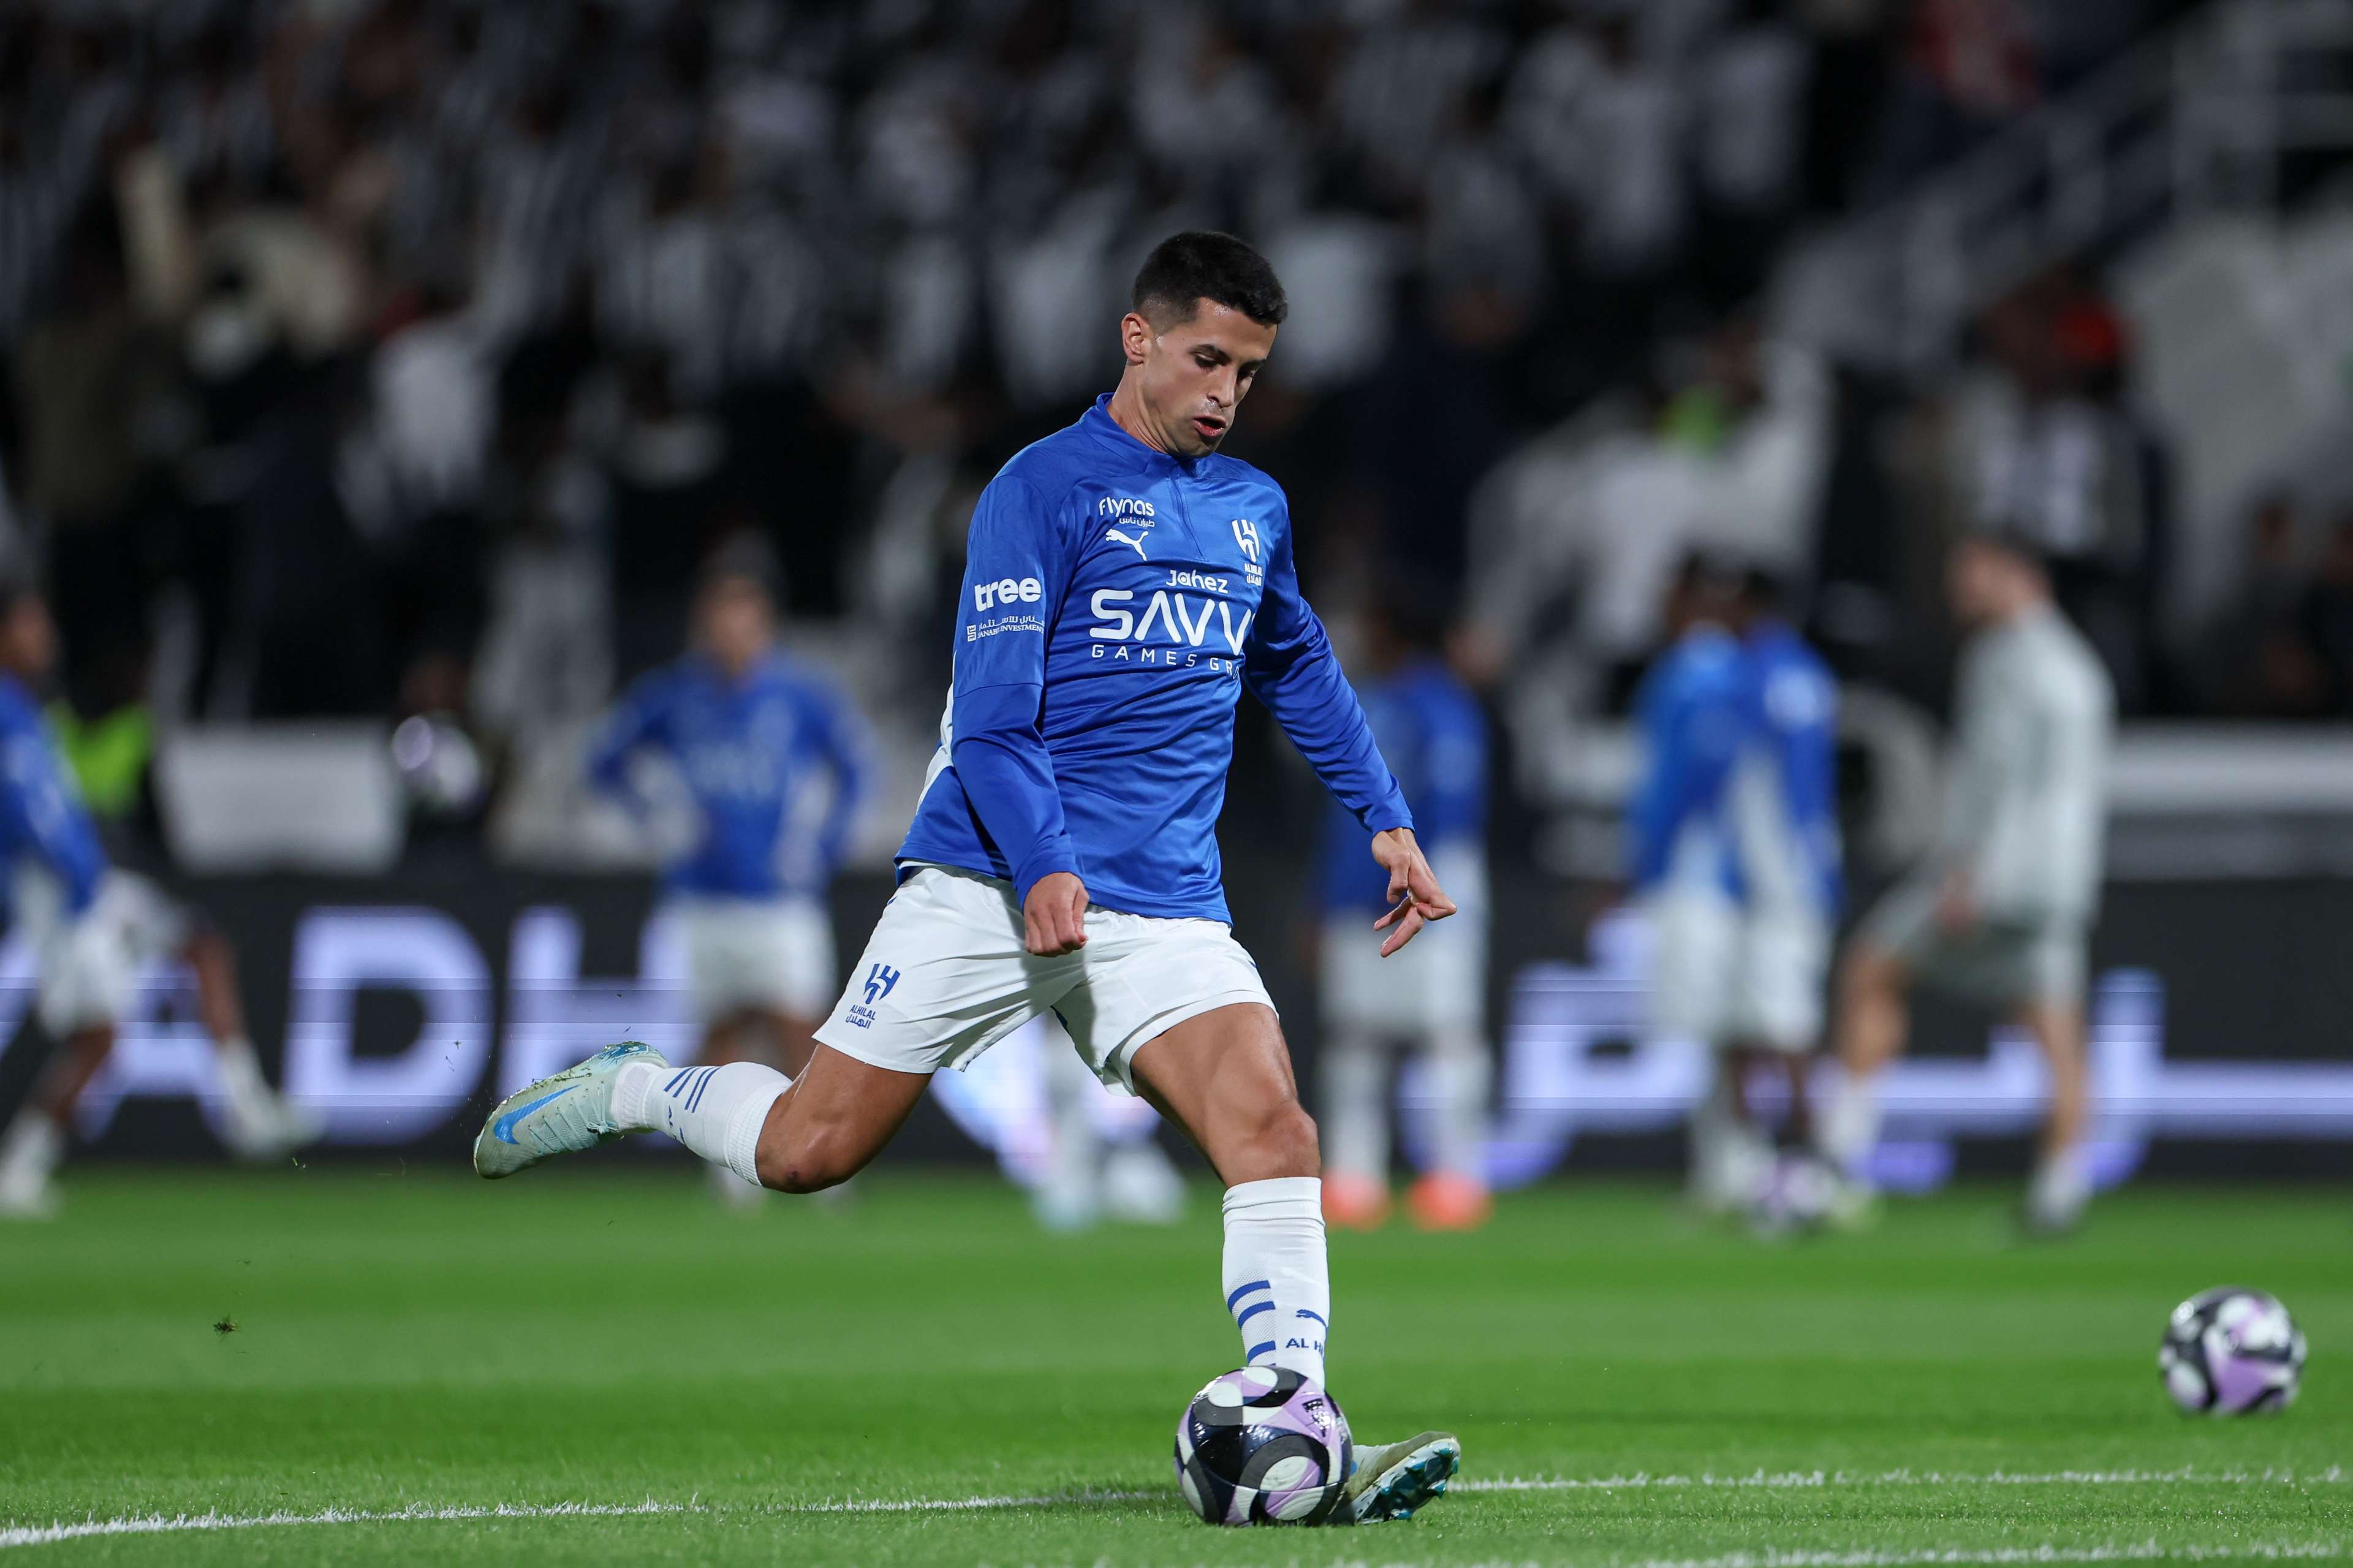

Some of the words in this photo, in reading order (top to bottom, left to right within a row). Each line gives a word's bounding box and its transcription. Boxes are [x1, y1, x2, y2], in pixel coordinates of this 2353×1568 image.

[1099, 497, 1155, 518] flynas
[1137, 518, 1155, 528] طيران
[1166, 569, 1228, 594] Jahez
[974, 577, 1042, 612] tree
[1000, 624, 1044, 634] INVESTMENT
[1089, 588, 1256, 656] SAVV
[1091, 644, 1197, 667] GAMES
[1210, 657, 1240, 680] GRO
[849, 1004, 876, 1020] ALHILAL
[0, 903, 705, 1147] ADH
[1286, 1338, 1309, 1349] AL
